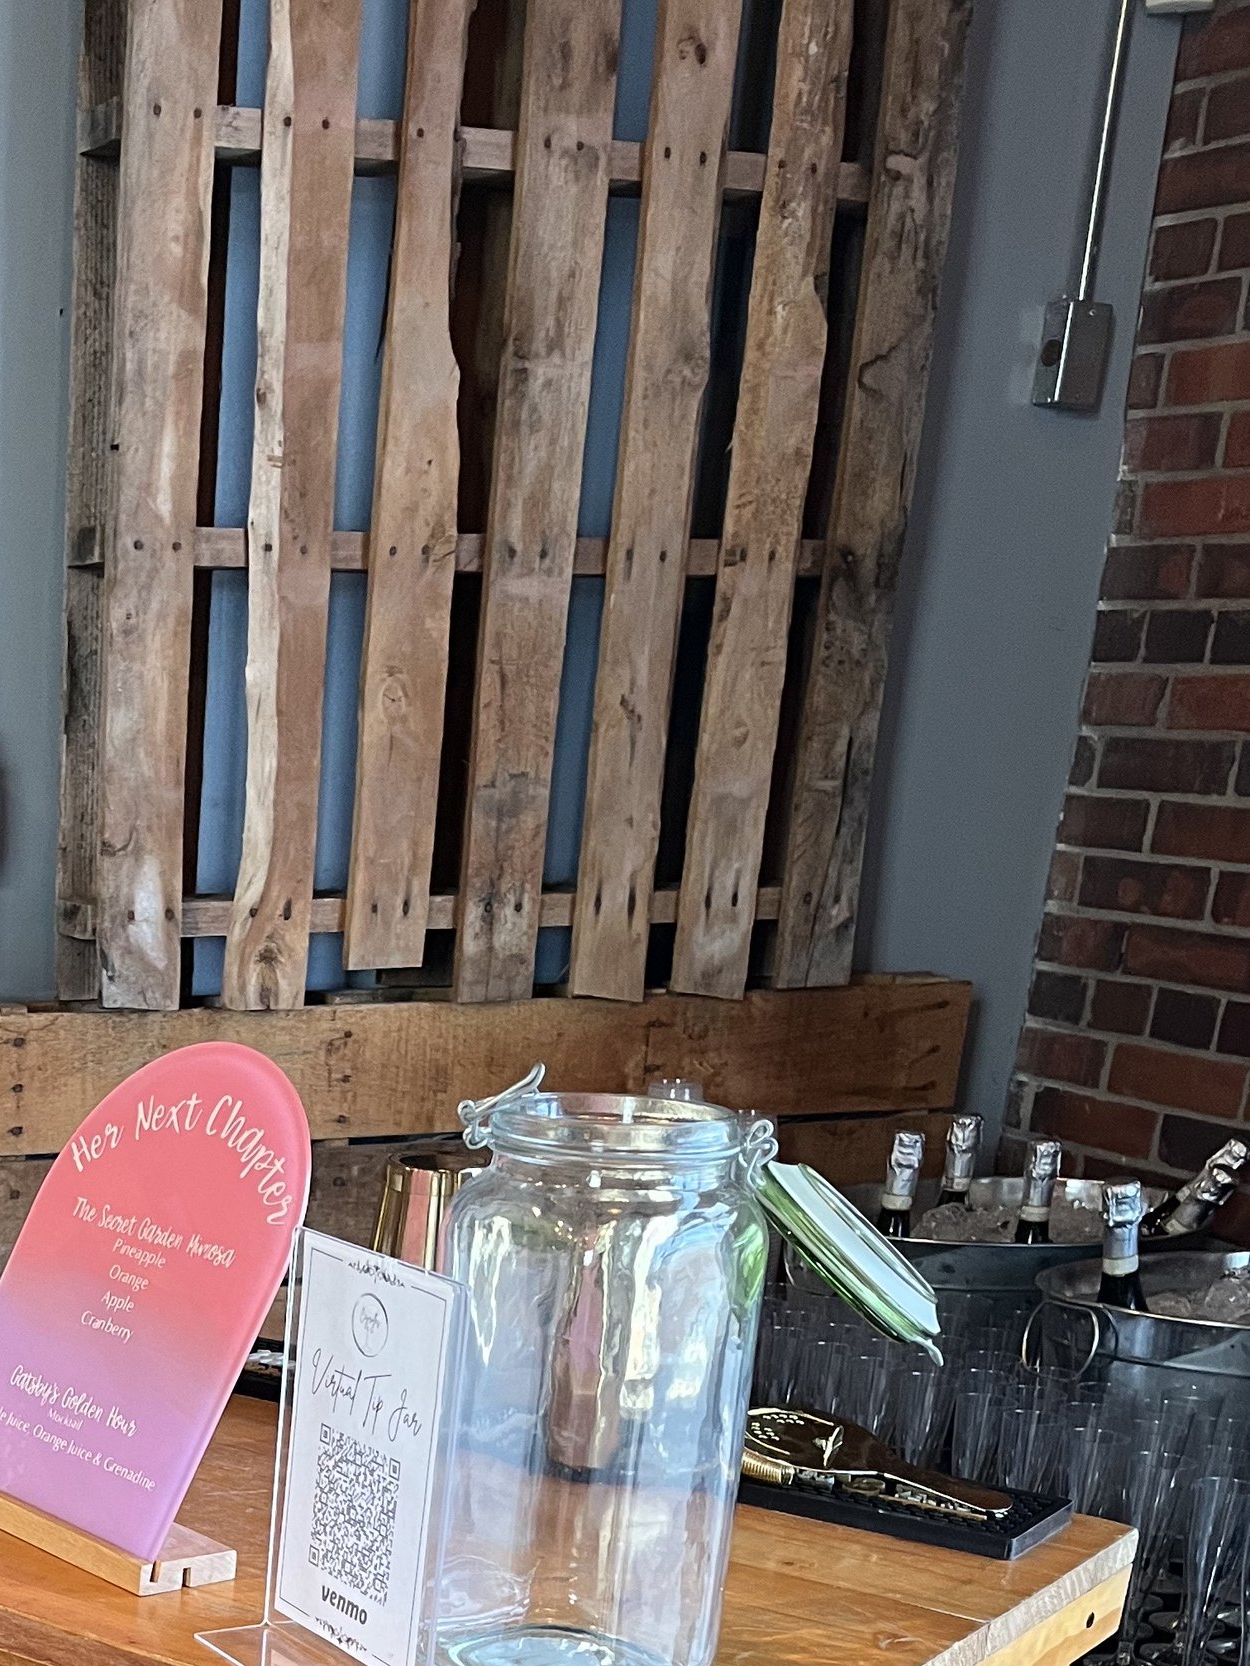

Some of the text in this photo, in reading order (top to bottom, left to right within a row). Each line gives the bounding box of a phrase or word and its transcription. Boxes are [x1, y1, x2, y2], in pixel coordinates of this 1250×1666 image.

[71, 1093, 293, 1225] Her Next Chapter
[73, 1196, 236, 1268] The Secret Garden Mimosa
[112, 1238, 166, 1268] Pineapple
[109, 1264, 149, 1292] Orange
[101, 1290, 135, 1313] Apple
[81, 1310, 134, 1344] Cranberry
[10, 1364, 138, 1438] Gatsby's Golden Hour
[312, 1348, 422, 1442] Virtual Tip Jar
[49, 1408, 84, 1431] Mocktail
[6, 1411, 31, 1435] Juice,
[33, 1424, 67, 1451] Orange
[67, 1440, 92, 1462] Juice
[92, 1453, 101, 1467] &
[103, 1456, 156, 1492] Grenadine
[321, 1585, 368, 1625] venmo
